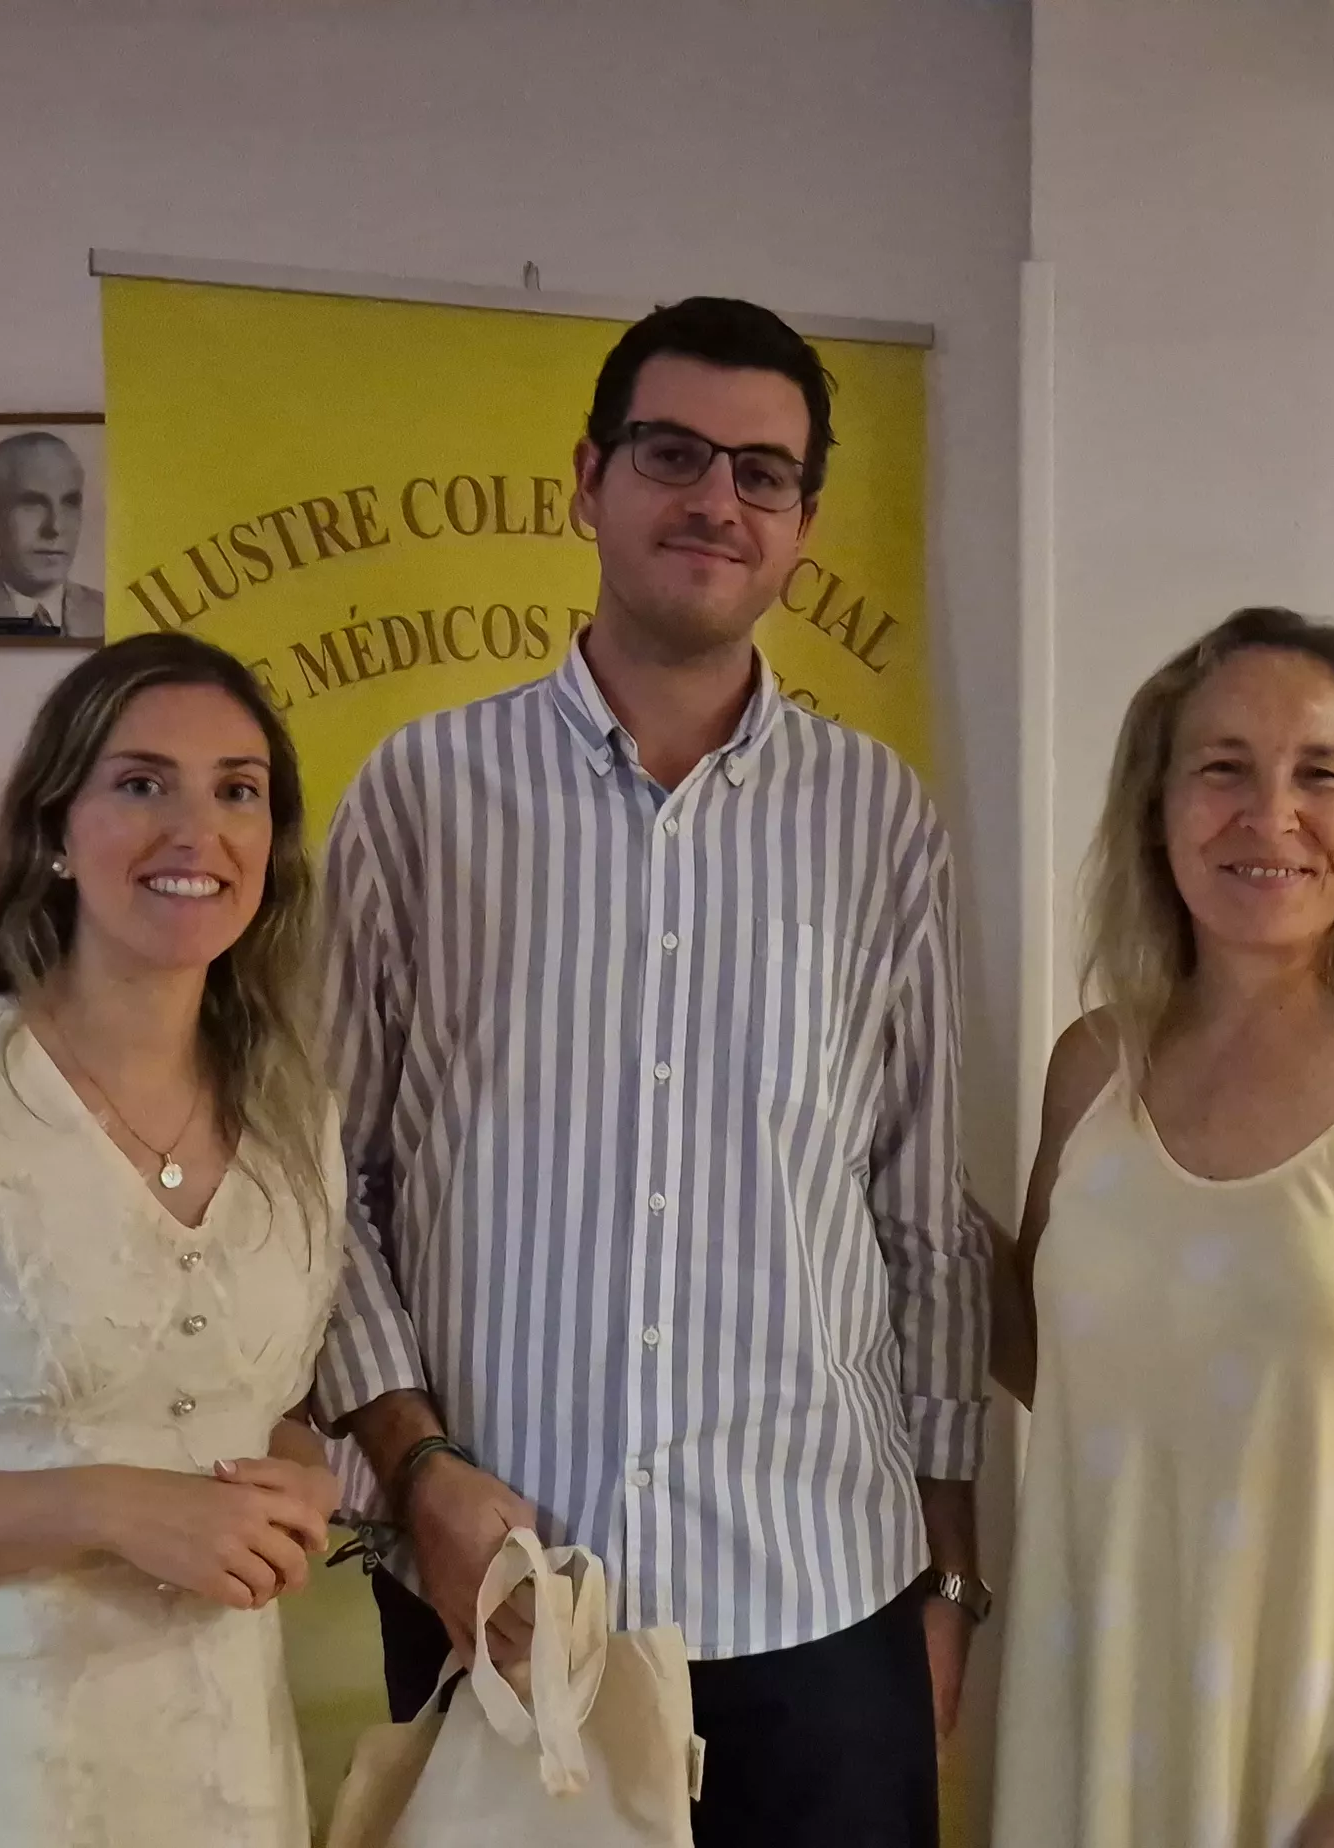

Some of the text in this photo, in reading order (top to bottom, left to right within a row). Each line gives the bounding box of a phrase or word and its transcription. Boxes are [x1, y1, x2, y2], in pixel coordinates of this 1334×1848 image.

[127, 485, 391, 634] ILUSTRE
[780, 558, 899, 674] CIAL
[289, 604, 551, 699] MÉDICOS
